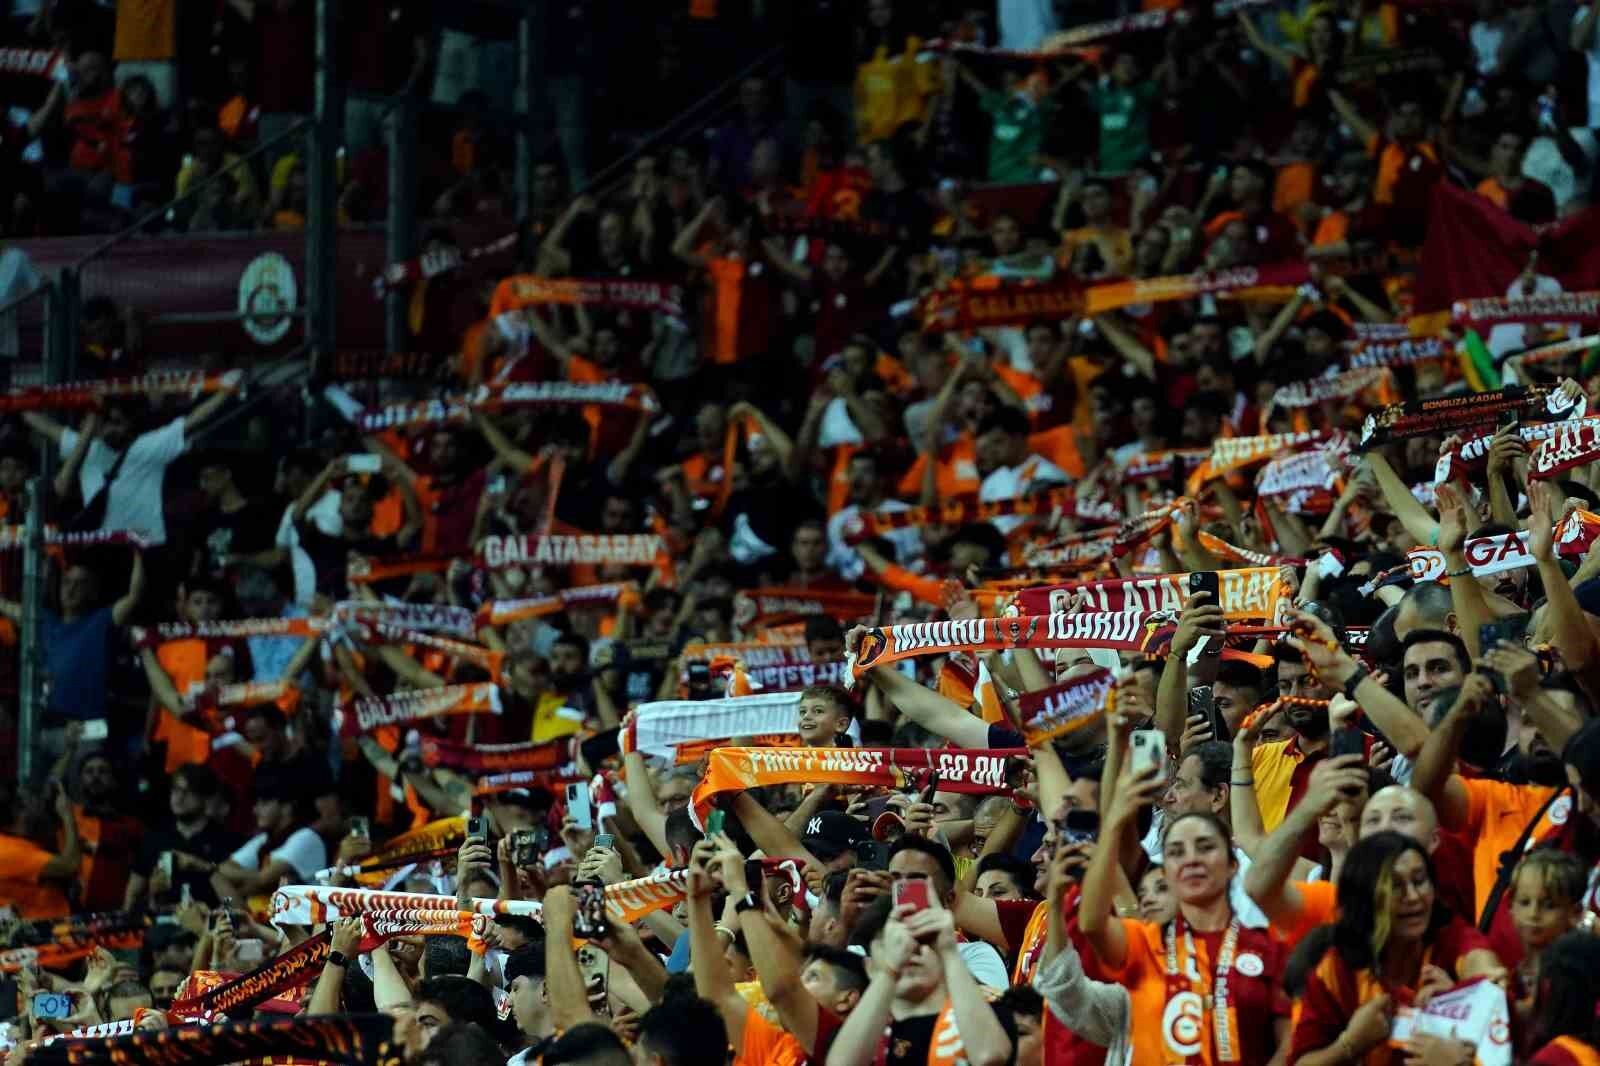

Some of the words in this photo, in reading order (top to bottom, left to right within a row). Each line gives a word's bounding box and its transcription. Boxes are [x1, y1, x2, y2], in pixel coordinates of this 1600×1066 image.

[484, 533, 661, 566] GALATASARAY
[1047, 611, 1141, 642] ICARDI
[820, 752, 883, 773] MUST
[939, 754, 968, 779] GO
[806, 816, 822, 834] NY
